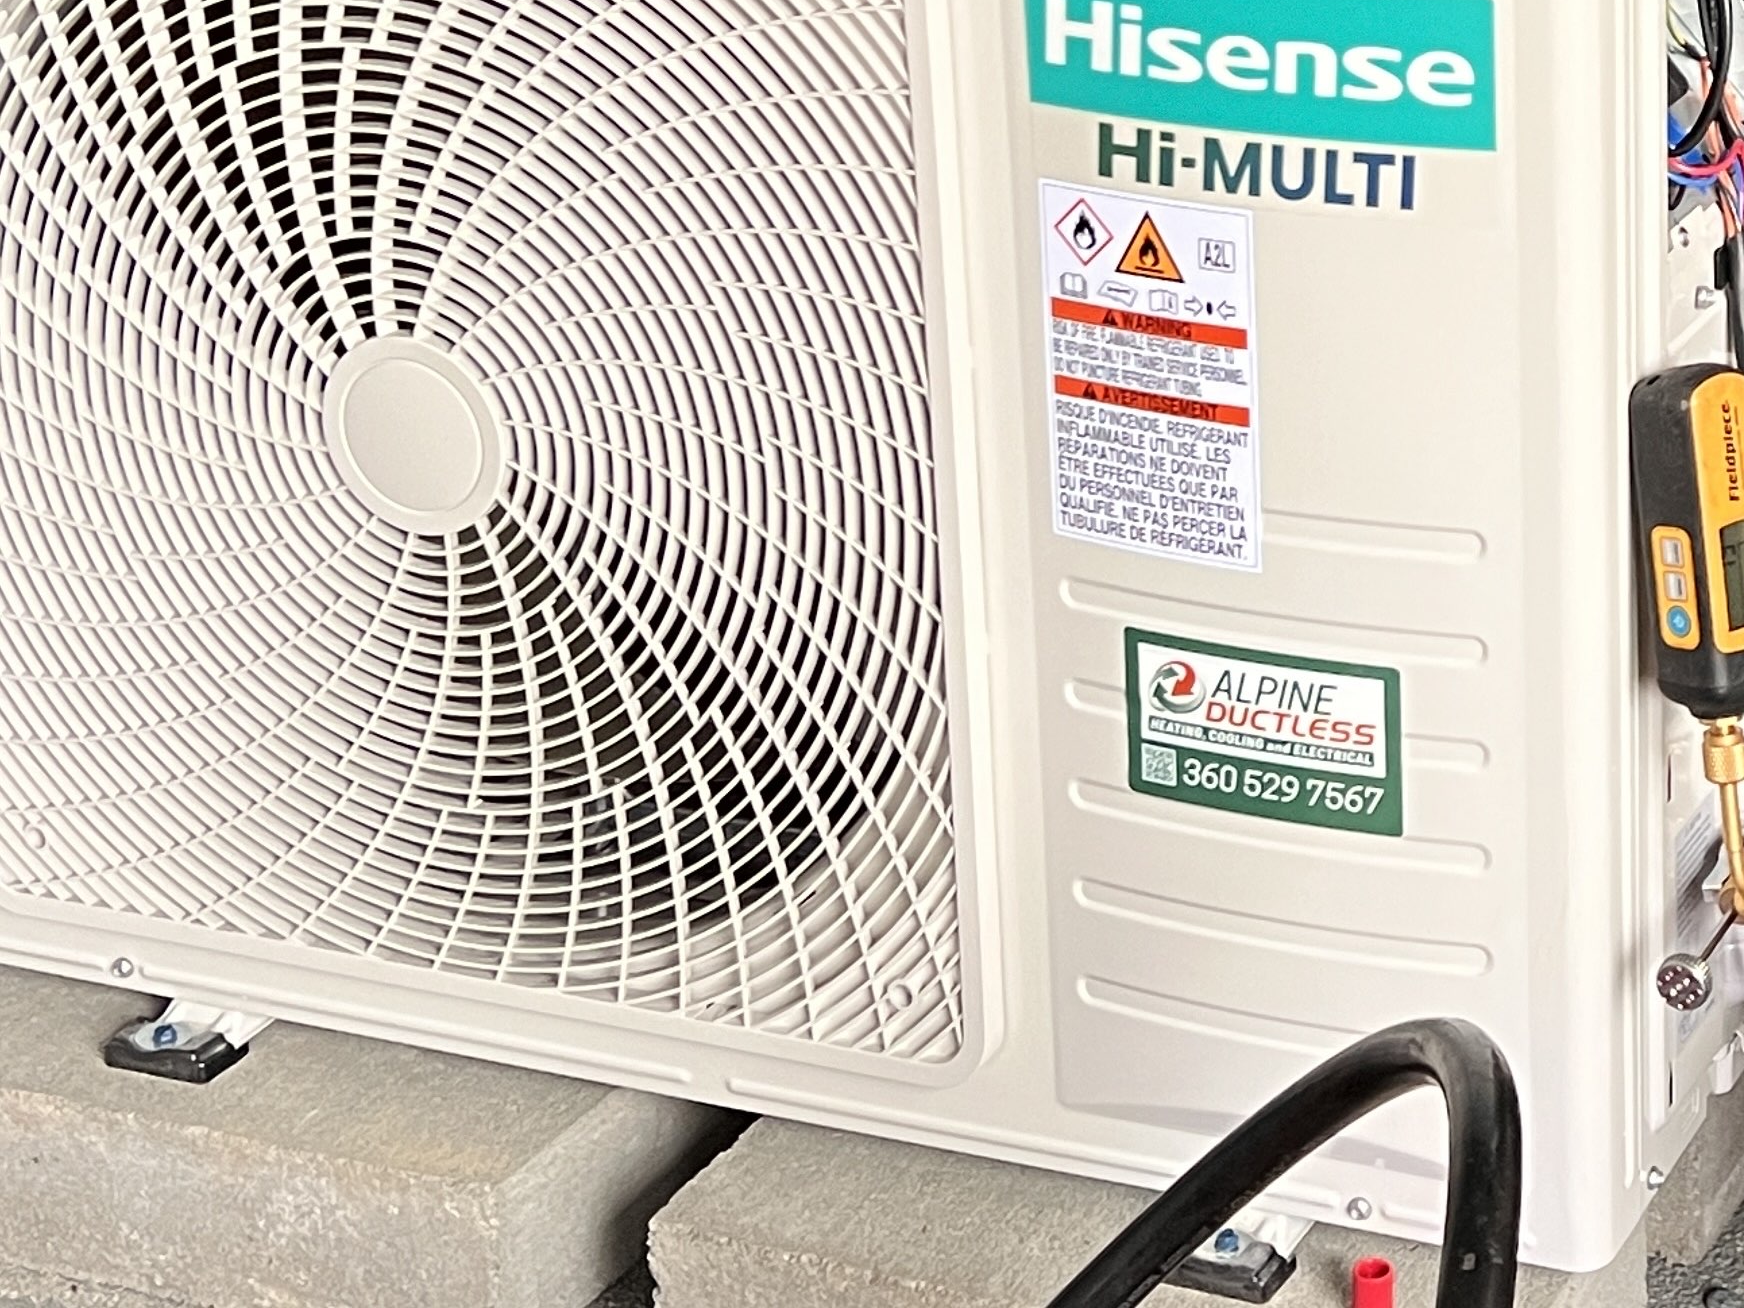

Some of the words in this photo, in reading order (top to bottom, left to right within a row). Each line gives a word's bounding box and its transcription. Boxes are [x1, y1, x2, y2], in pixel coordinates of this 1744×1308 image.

[1098, 122, 1416, 211] Hi-MULTI
[1203, 242, 1230, 268] A2L
[1122, 310, 1192, 339] WARNING
[1206, 446, 1231, 464] LES
[1721, 402, 1740, 502] Fieldpiece
[1059, 473, 1076, 491] DU
[1150, 456, 1166, 472] NE
[1171, 459, 1228, 482] DOIVENT
[1179, 478, 1207, 498] QUE
[1211, 484, 1238, 503] PAR
[1122, 505, 1139, 523] NE
[1144, 508, 1168, 529] PAS
[1172, 514, 1225, 538] PERCER
[1230, 524, 1248, 542] LA
[1130, 525, 1147, 543] DE
[1211, 669, 1338, 716] ALPINE
[1205, 701, 1377, 746] DUCTLESS
[1149, 717, 1206, 741] HEATING,
[1208, 726, 1264, 750] COOLING
[1267, 740, 1291, 756] and
[1293, 745, 1374, 767] ELECTRICAL
[1182, 757, 1238, 794] 360
[1243, 768, 1300, 803] 529
[1305, 778, 1385, 815] 7567
